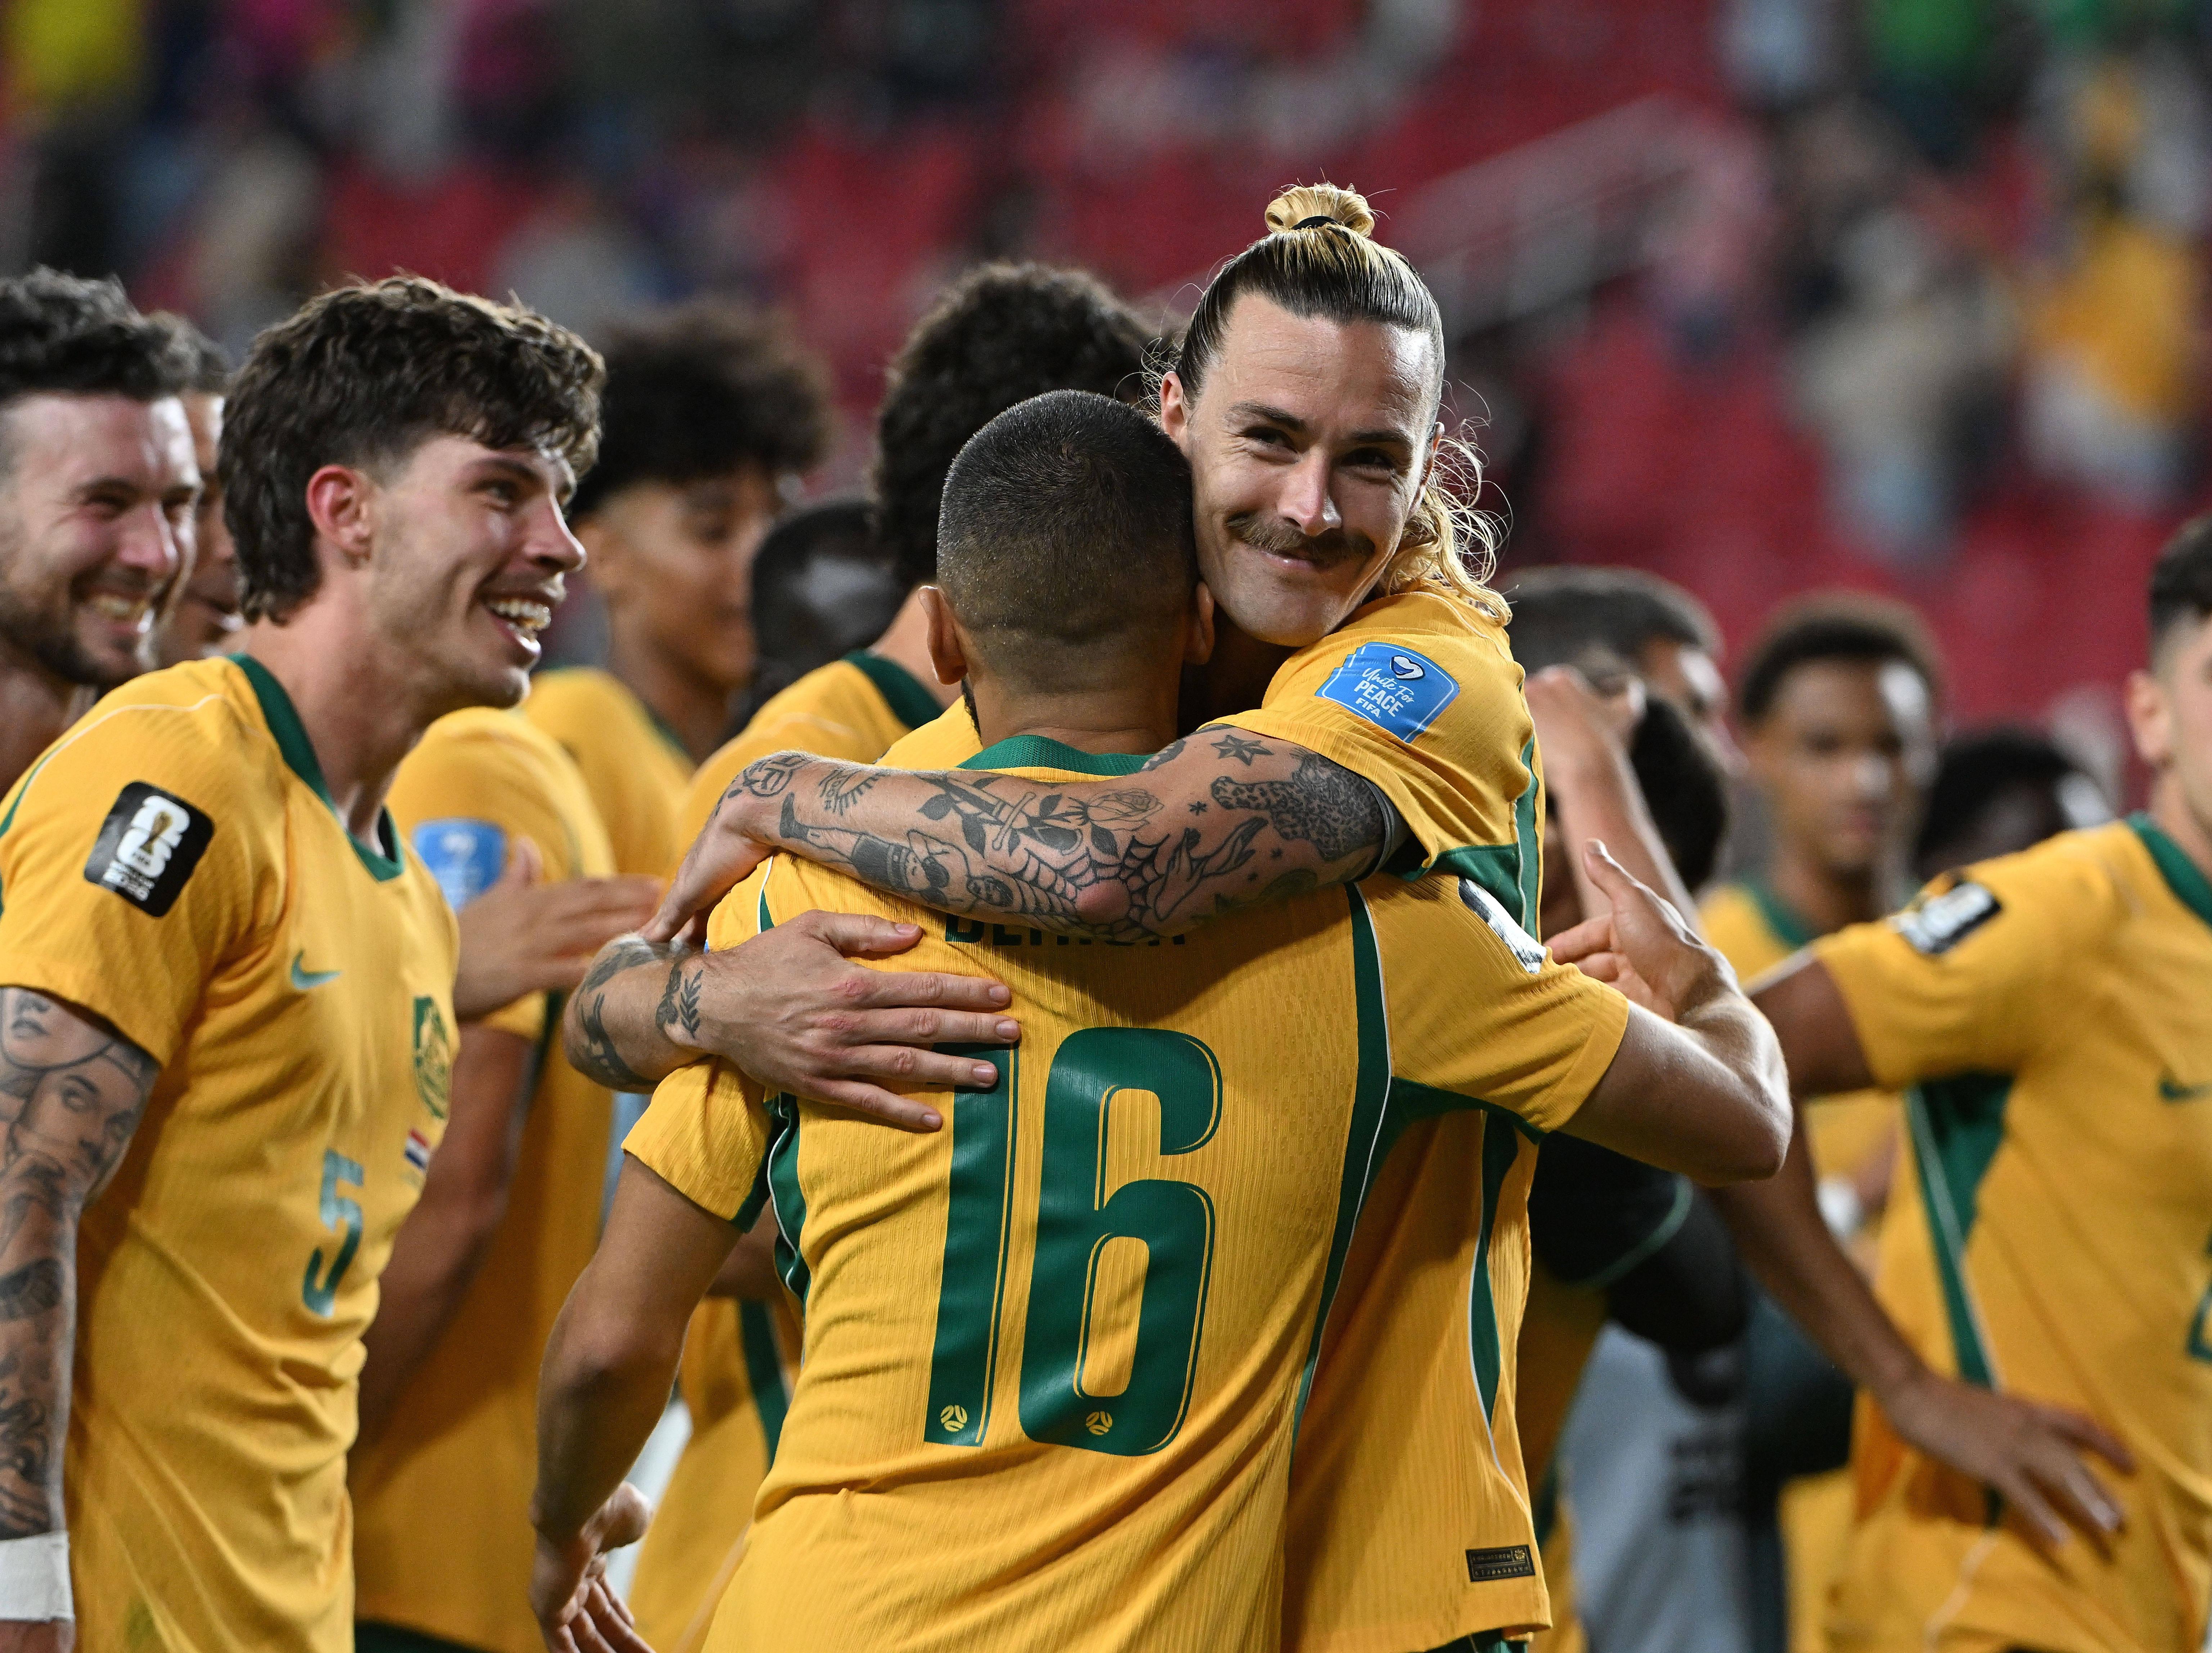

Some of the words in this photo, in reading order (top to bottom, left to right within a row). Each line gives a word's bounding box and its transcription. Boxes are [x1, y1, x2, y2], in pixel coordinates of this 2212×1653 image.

[1353, 680, 1404, 717] PEACE
[1362, 668, 1397, 690] Unite
[1394, 685, 1415, 703] For
[1355, 697, 1381, 718] FIFA
[302, 1148, 364, 1319] 5
[924, 1027, 1223, 1457] 16
